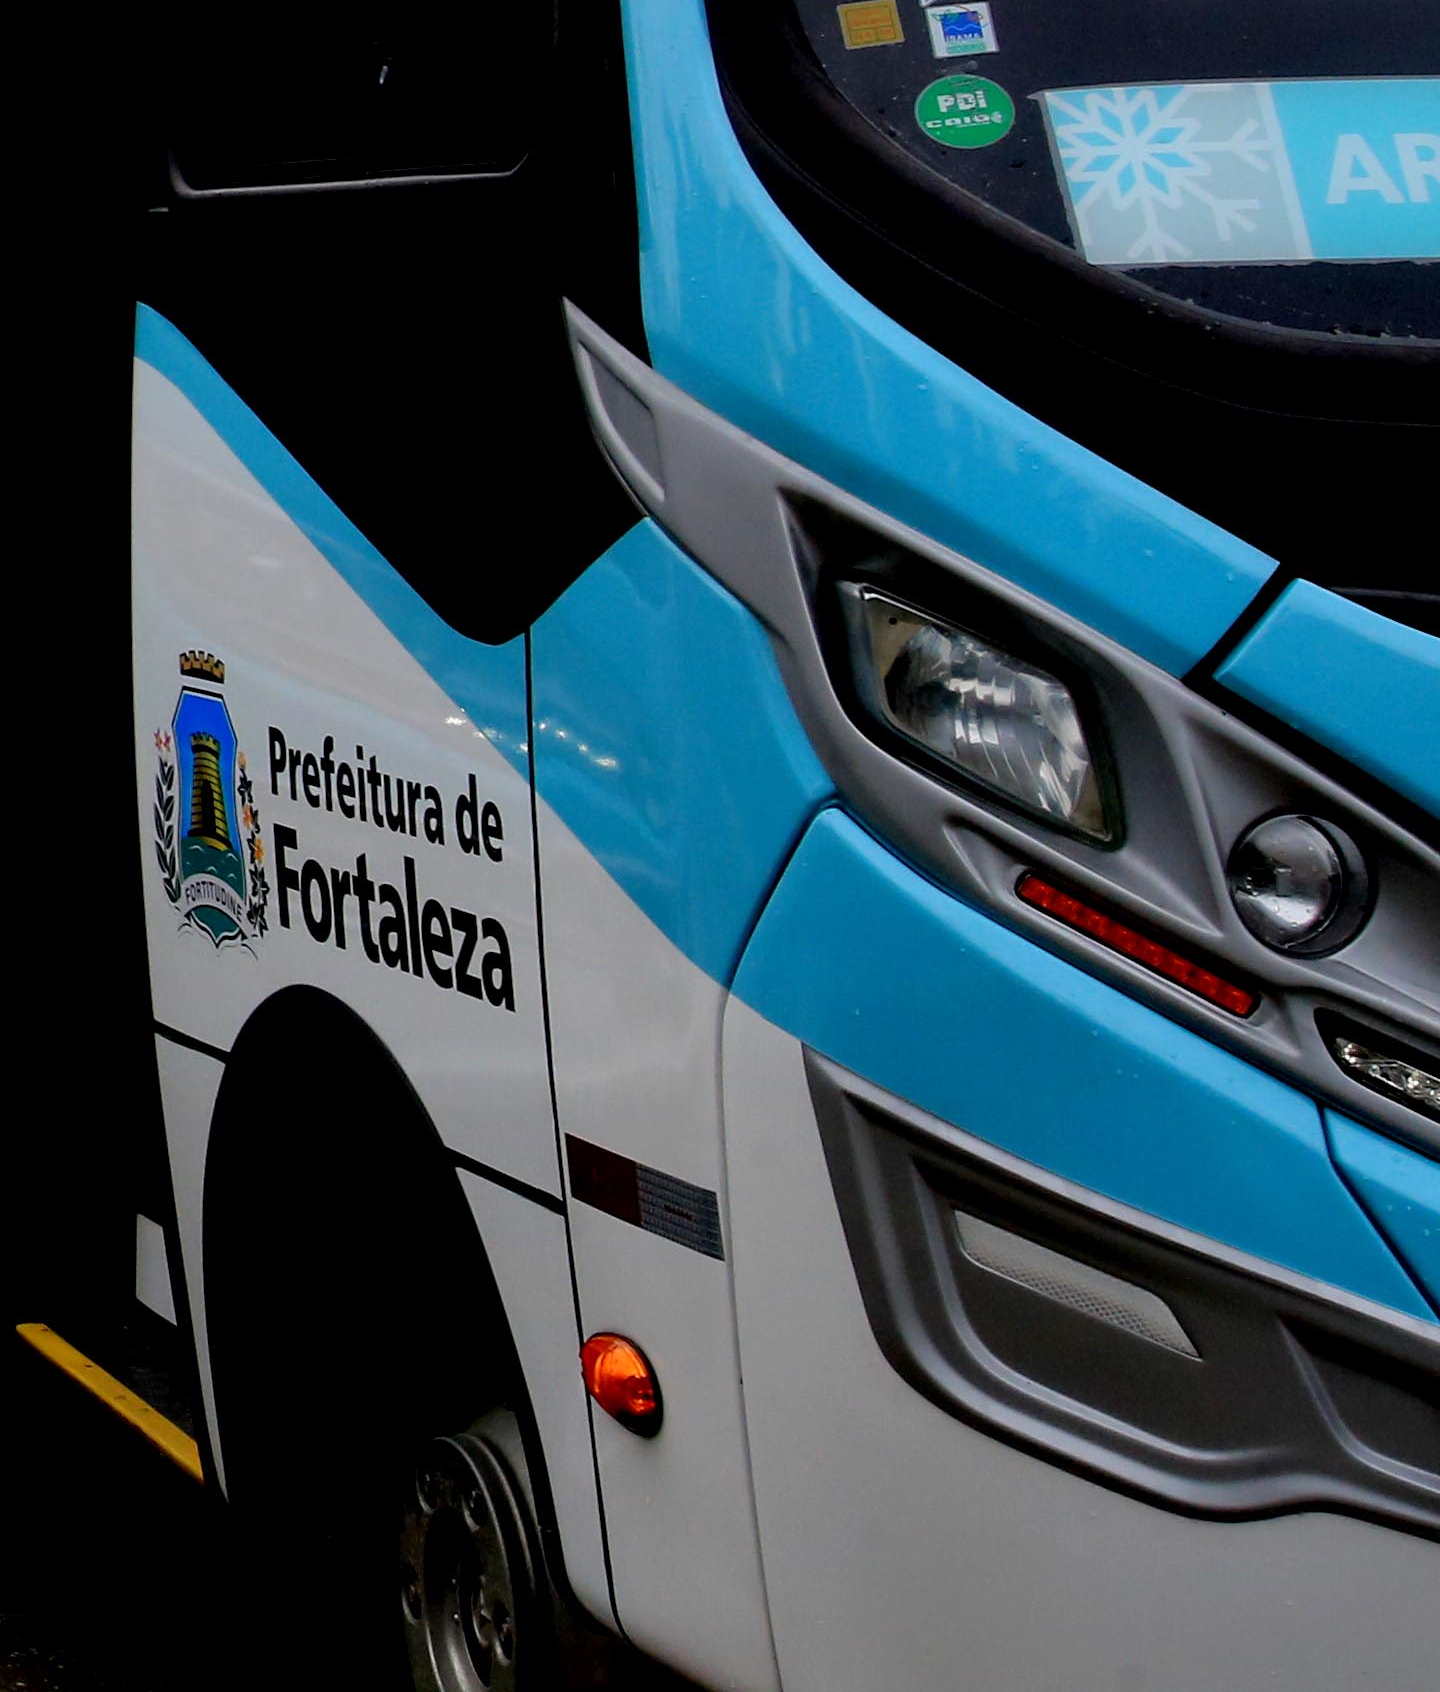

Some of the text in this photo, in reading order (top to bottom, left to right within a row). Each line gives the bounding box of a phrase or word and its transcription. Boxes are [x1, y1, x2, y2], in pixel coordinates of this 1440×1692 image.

[1326, 132, 1440, 204] AR
[268, 726, 503, 862] Prefeitura de
[185, 880, 242, 923] FORTITUDINE
[273, 823, 516, 1013] Fortaleza
